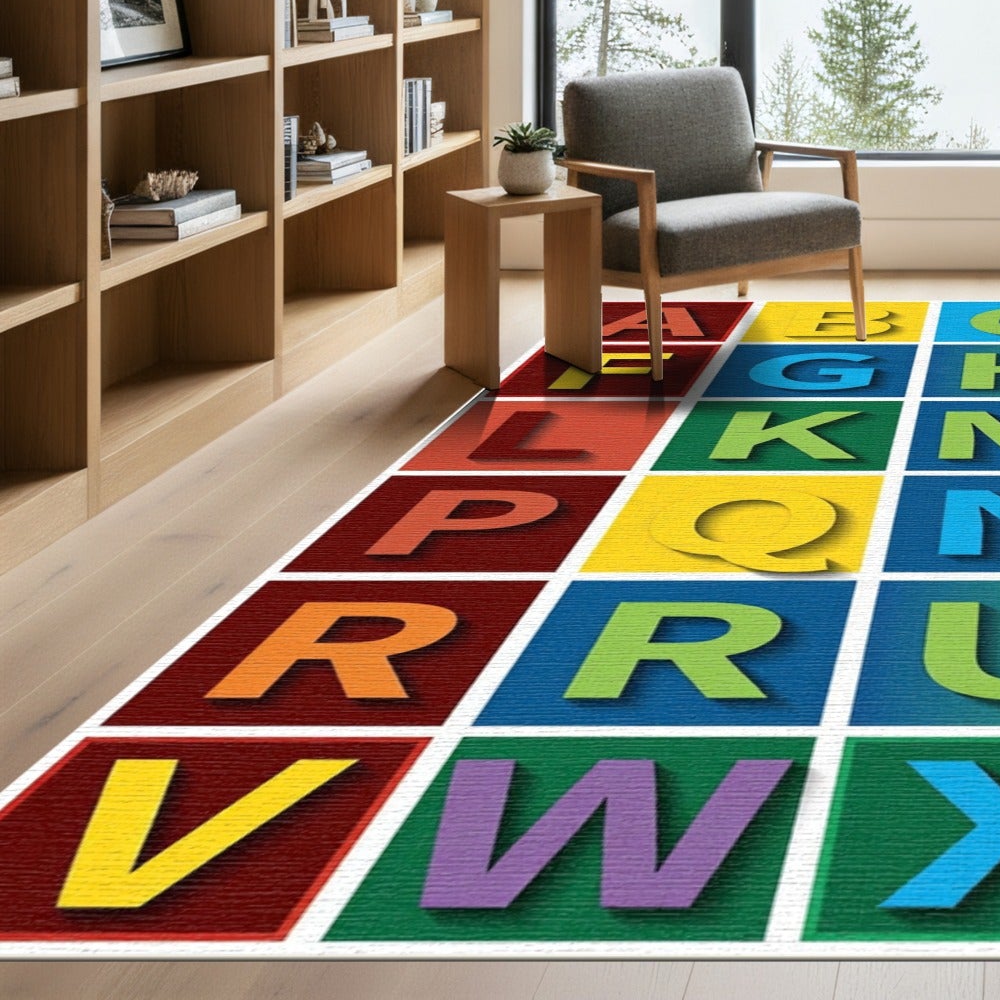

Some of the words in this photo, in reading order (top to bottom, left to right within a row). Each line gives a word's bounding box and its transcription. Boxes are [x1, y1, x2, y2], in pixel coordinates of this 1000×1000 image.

[602, 307, 705, 336] A
[785, 308, 893, 338] B
[547, 352, 673, 389] F
[749, 352, 876, 390] G
[468, 411, 587, 459] L
[709, 411, 862, 460] K
[366, 490, 559, 556] P
[649, 489, 837, 572] Q
[204, 601, 458, 699] R
[563, 601, 783, 699] R
[55, 759, 359, 908] V
[419, 759, 794, 908] W
